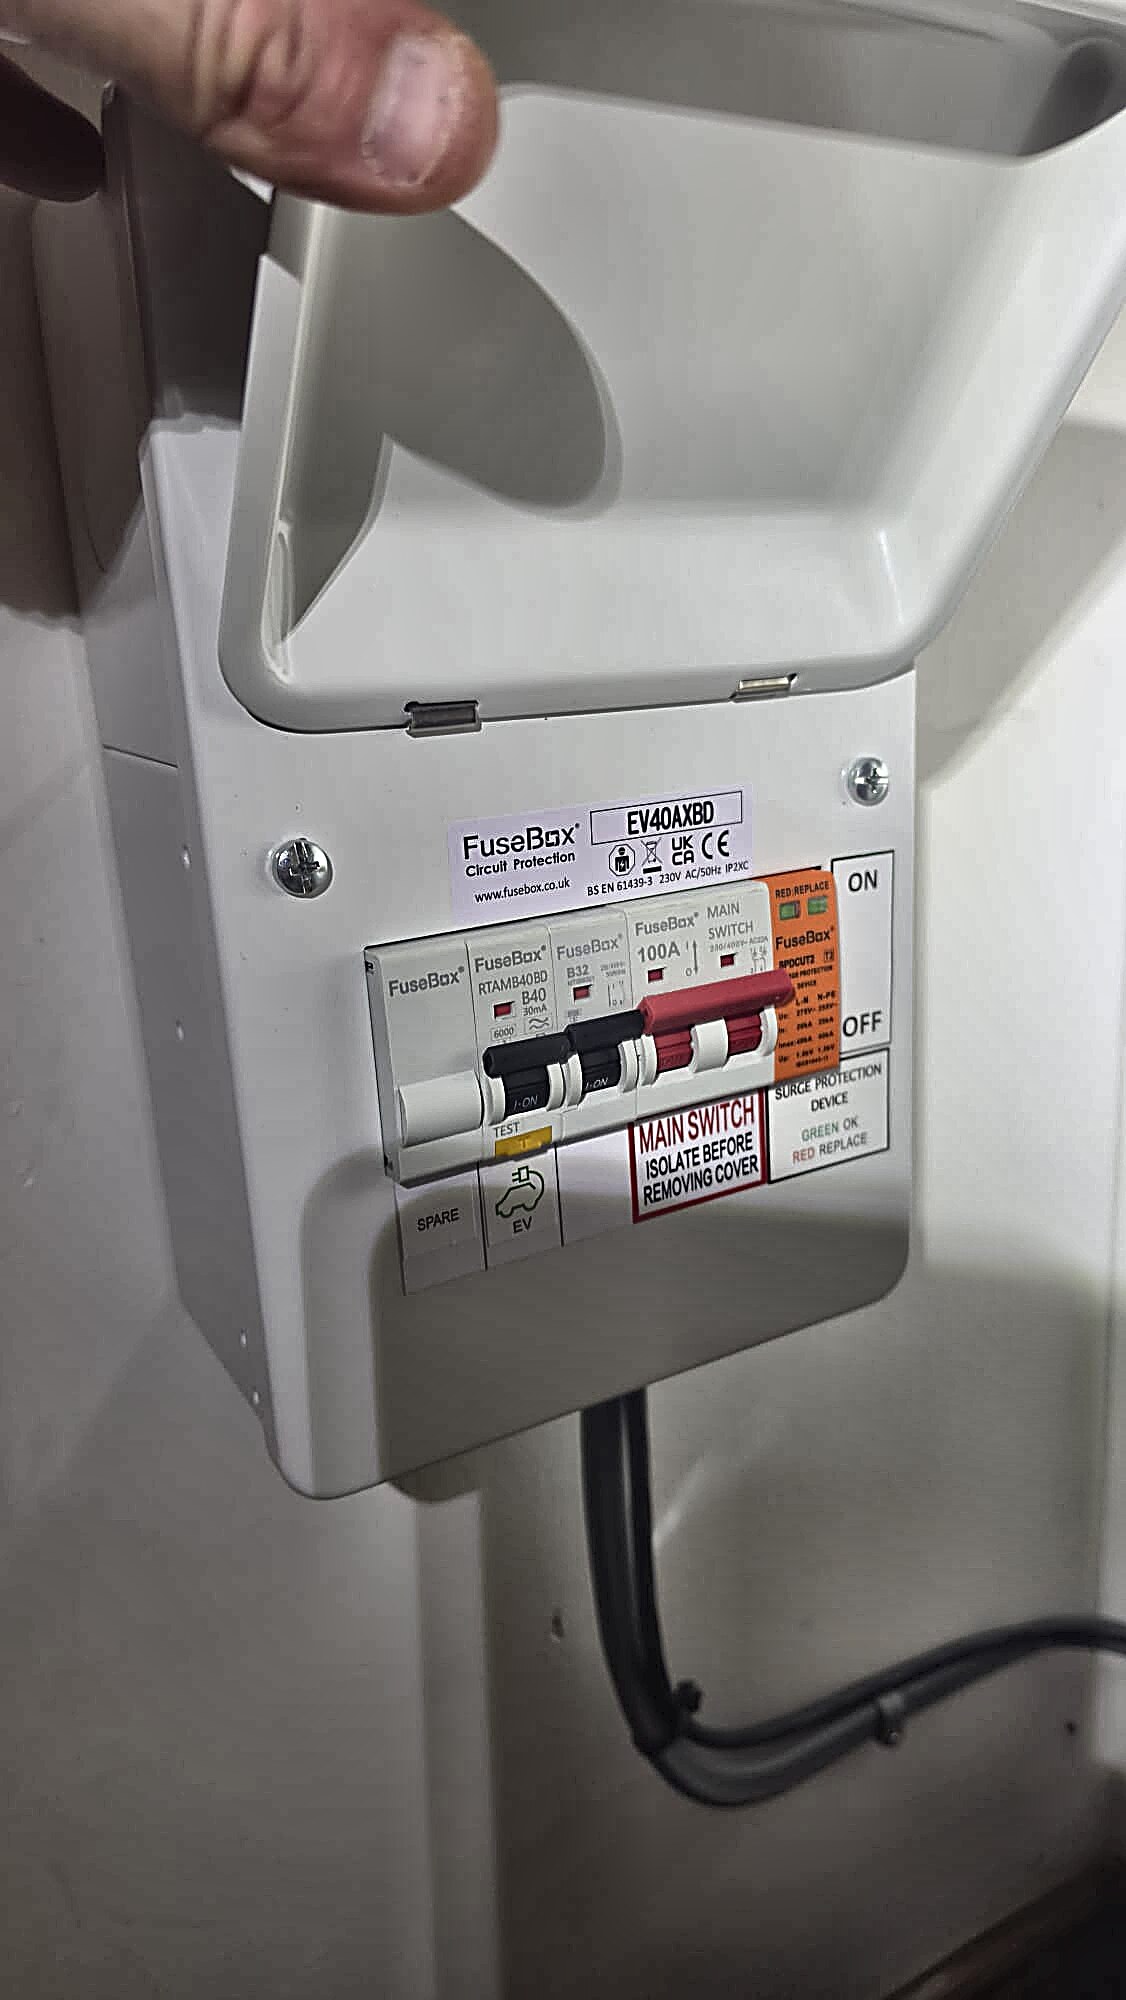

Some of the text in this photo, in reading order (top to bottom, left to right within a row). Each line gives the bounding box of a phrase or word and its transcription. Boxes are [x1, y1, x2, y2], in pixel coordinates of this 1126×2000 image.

[627, 801, 714, 835] EV40AXBD
[672, 835, 694, 850] UK
[465, 852, 576, 877] Circuit Protection
[672, 850, 695, 865] CA
[474, 877, 570, 903] www.fusebox.co.uk
[587, 861, 749, 896] BS EN 61439-3 230V AC/50Hz IP2XC
[848, 870, 878, 892] ON
[707, 901, 740, 919] MAIN
[708, 920, 753, 940] SWITCH
[638, 941, 681, 963] 100A
[567, 964, 589, 978] B32
[478, 970, 548, 996] RTAMB40BD
[522, 988, 547, 1005] B40
[523, 1004, 547, 1016] 30mA
[493, 1026, 514, 1039] 6000
[843, 1010, 882, 1037] OFF
[775, 1064, 882, 1100] SURGE PROTECTION
[811, 1091, 848, 1112] DEVICE
[494, 1122, 520, 1138] TEST
[640, 1095, 755, 1154] MAIN SWITCH
[801, 1115, 859, 1141] GREEN OK
[646, 1131, 753, 1180] ISOLATE BEFORE
[792, 1131, 868, 1164] RED REPLACE
[643, 1154, 759, 1206] REMOVING COVER
[417, 1208, 460, 1232] SPARE
[512, 1217, 533, 1234] EV
